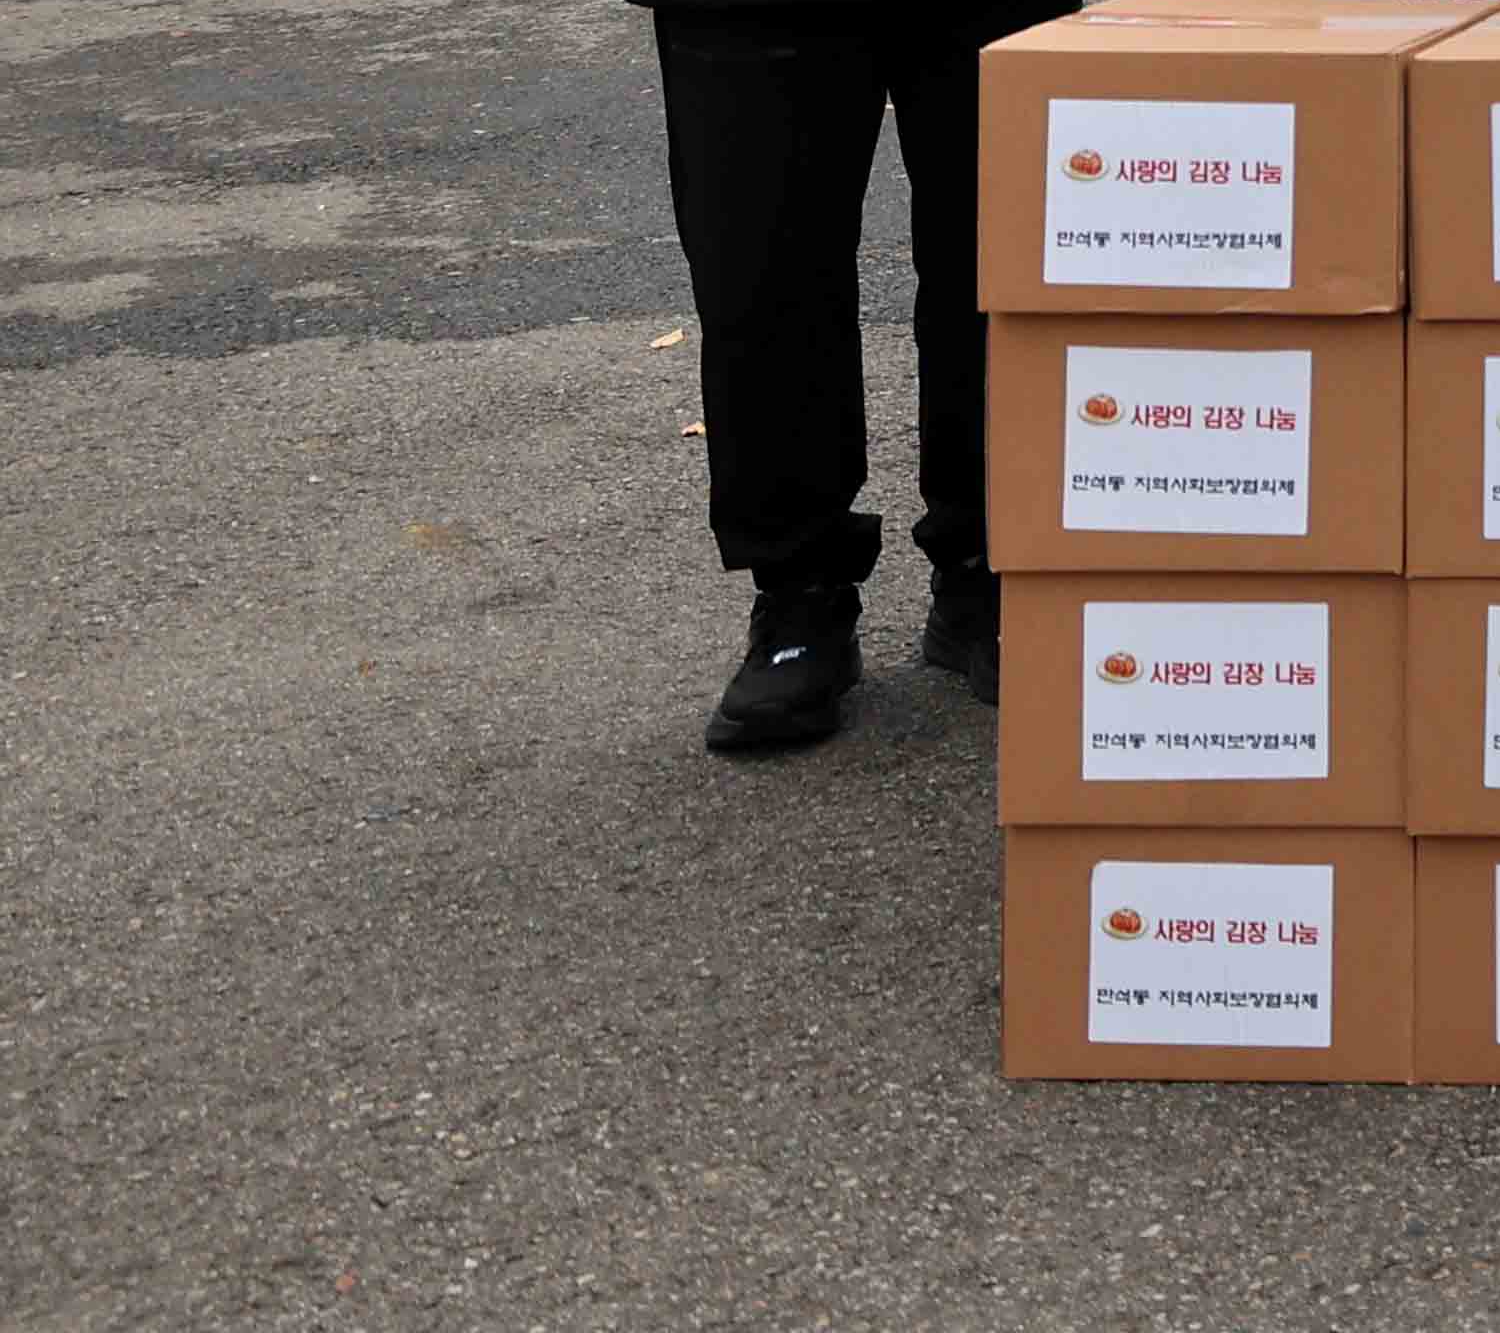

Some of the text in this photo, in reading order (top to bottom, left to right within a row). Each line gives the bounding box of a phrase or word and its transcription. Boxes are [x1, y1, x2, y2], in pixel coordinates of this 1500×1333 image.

[1129, 403, 1298, 433] 사랑의 김장 나눔
[1152, 917, 1320, 947] 사랑의 김장 나눔
